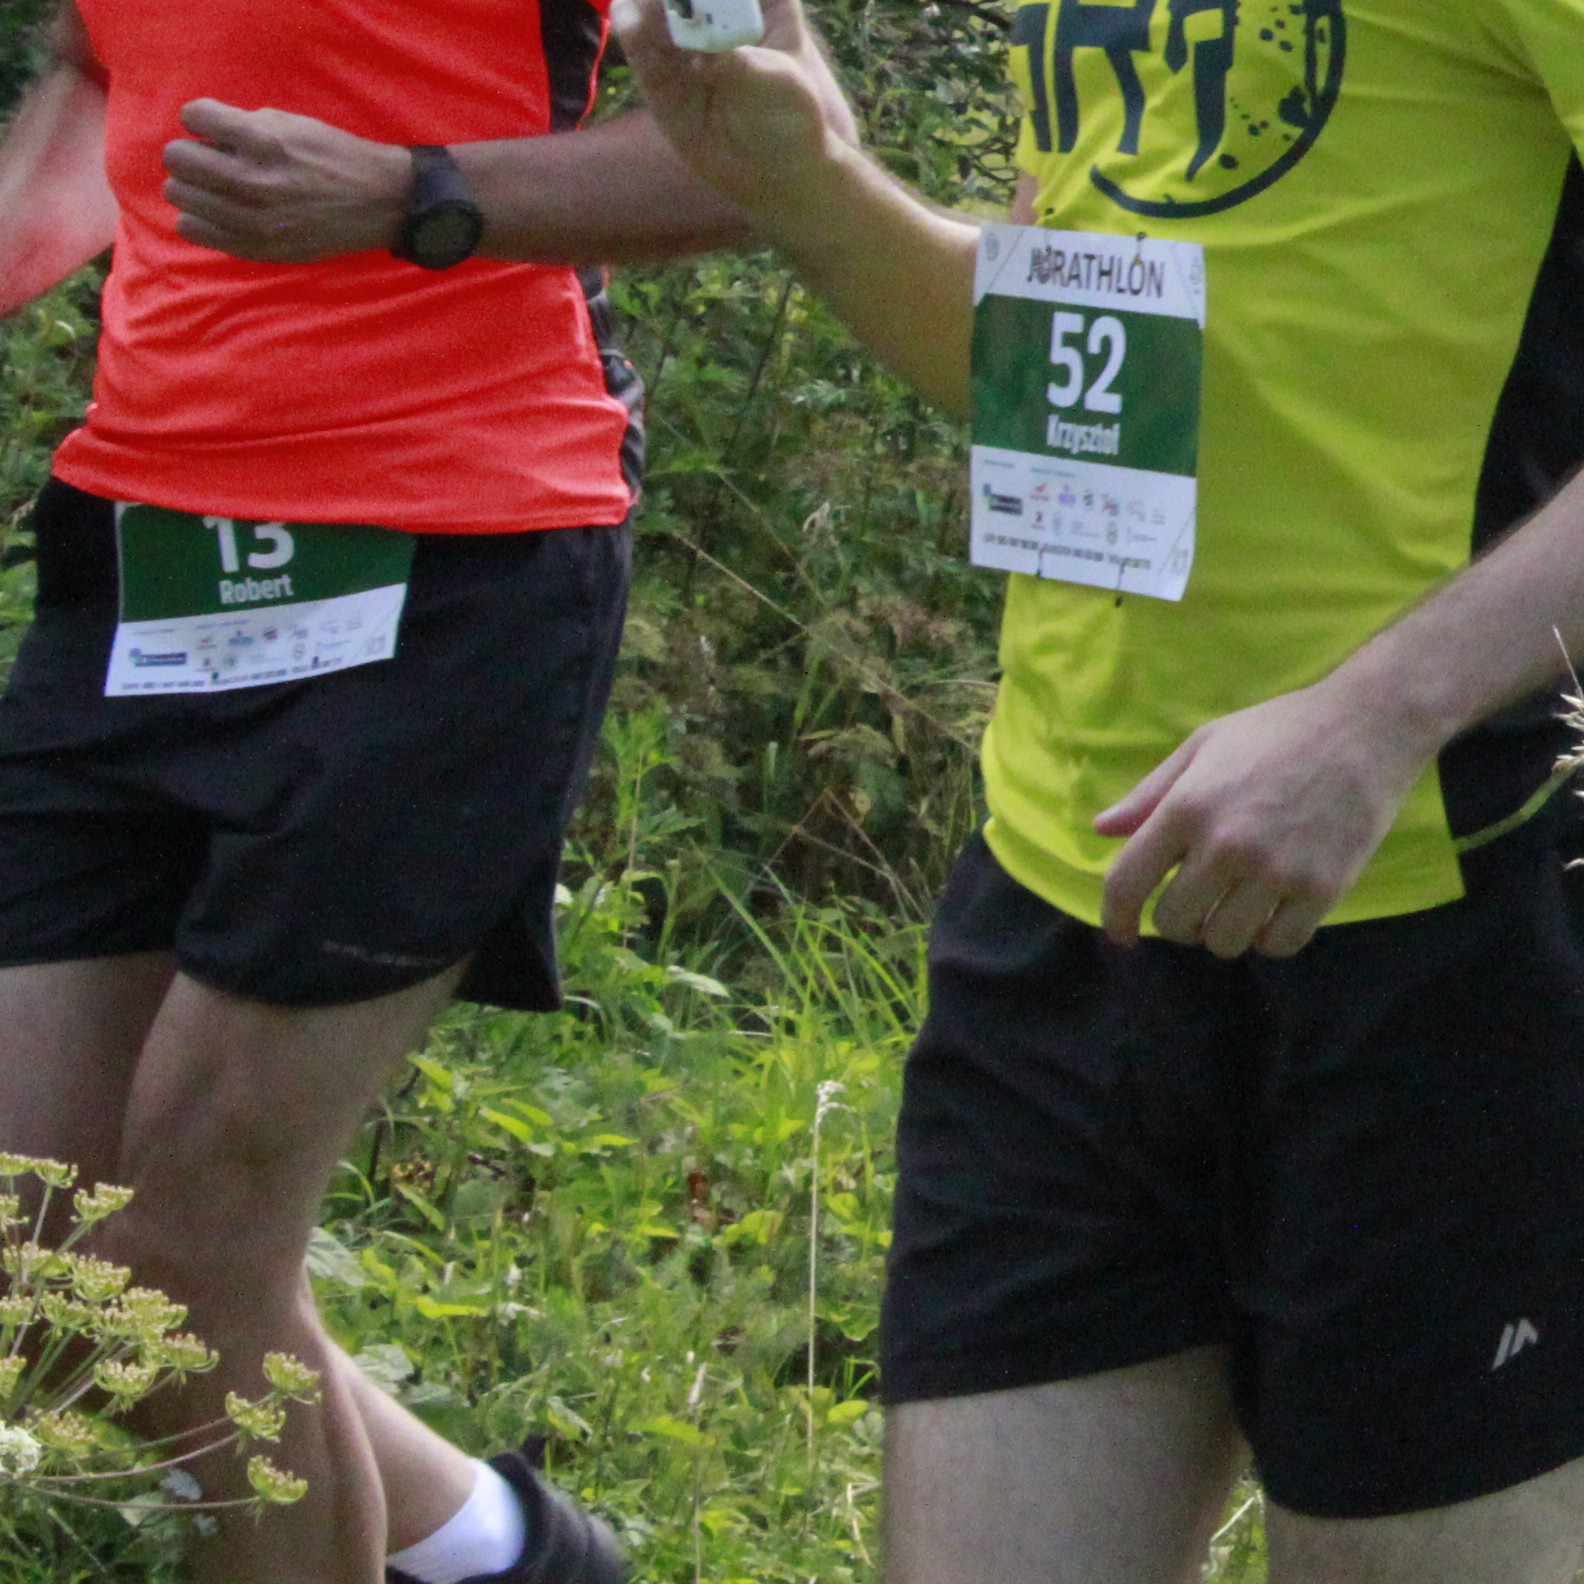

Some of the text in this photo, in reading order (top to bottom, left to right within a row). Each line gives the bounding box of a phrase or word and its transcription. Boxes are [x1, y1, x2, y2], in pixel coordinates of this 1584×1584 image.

[1046, 311, 1127, 415] 52
[1046, 415, 1122, 455] Krzysztof
[219, 574, 294, 605] Robert
